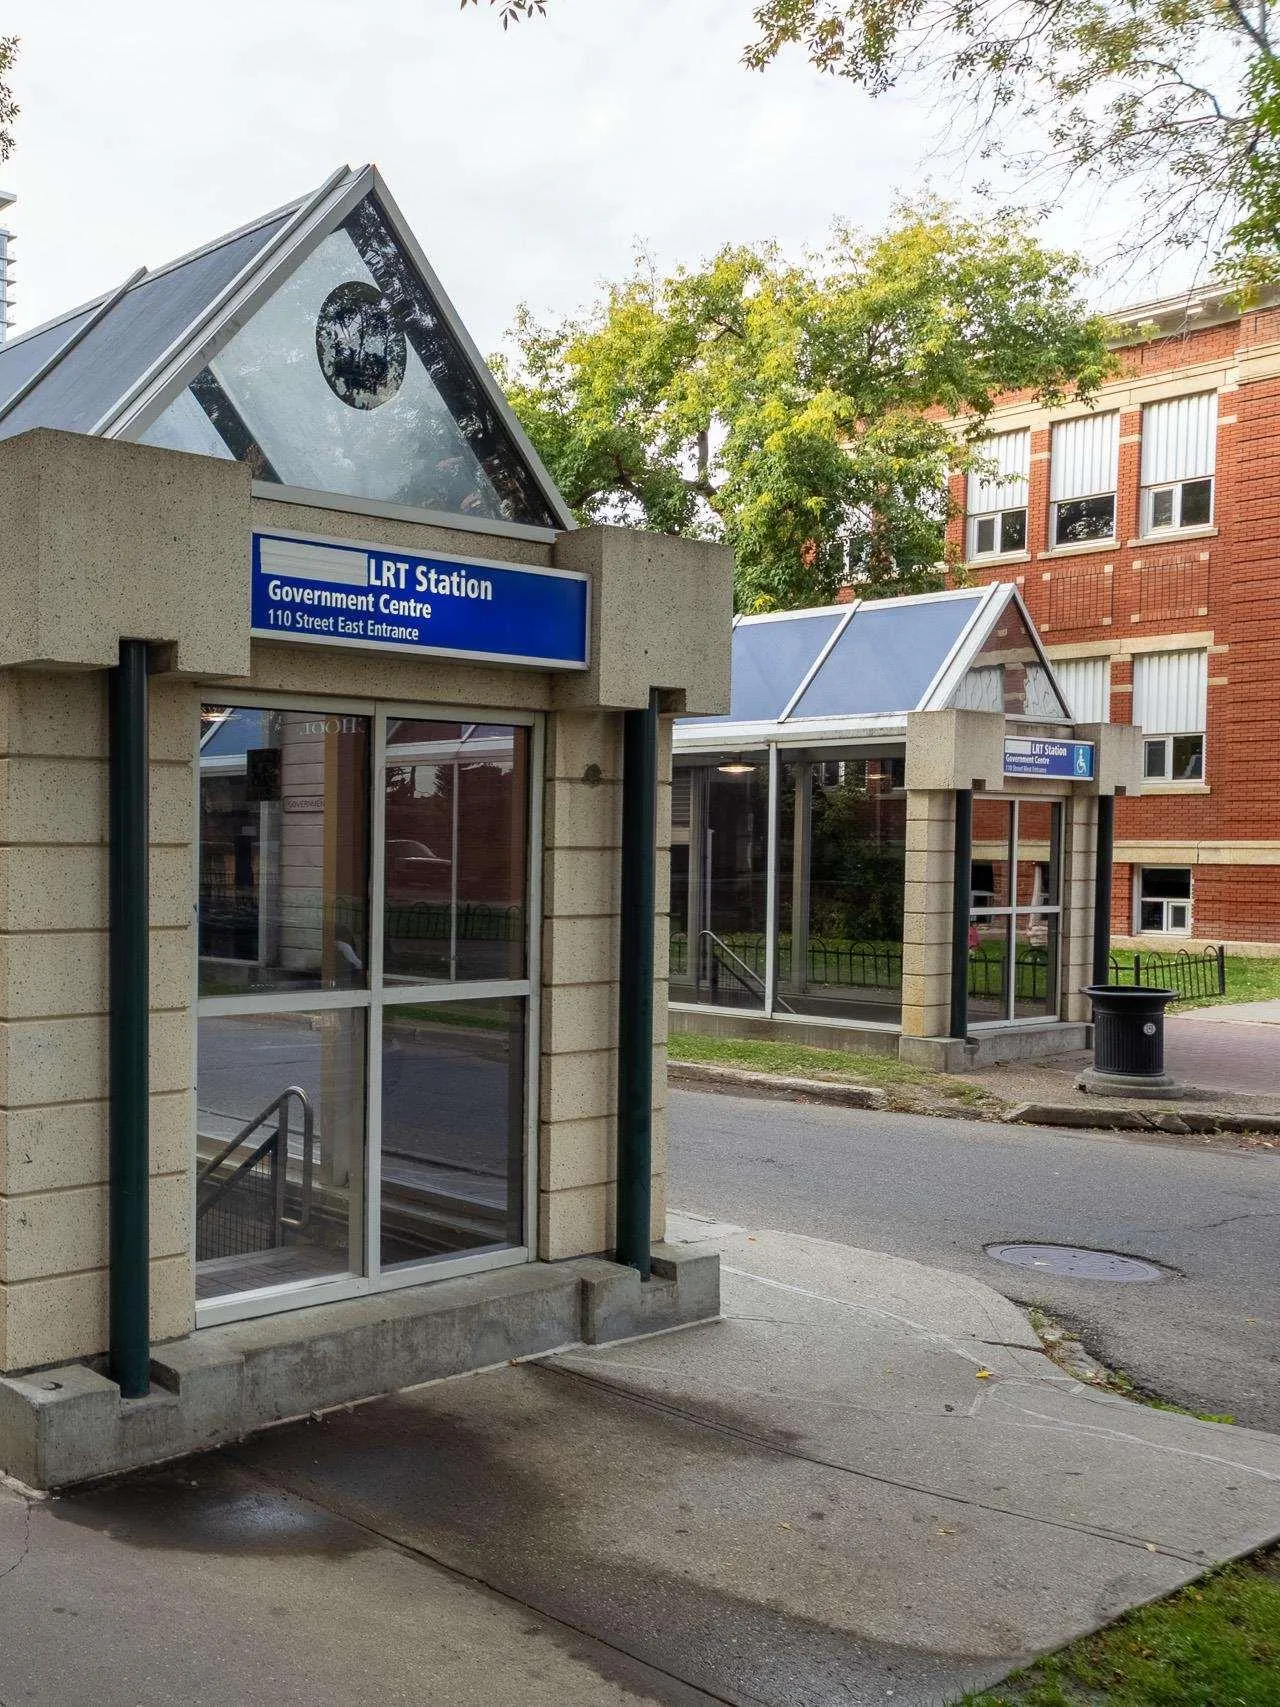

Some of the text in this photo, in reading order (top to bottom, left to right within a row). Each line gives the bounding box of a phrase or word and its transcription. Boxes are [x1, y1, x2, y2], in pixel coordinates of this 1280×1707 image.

[369, 558, 493, 600] LRT Station
[268, 579, 432, 619] Government Centre
[268, 608, 419, 640] 110 Street East Entrance
[1005, 753, 1035, 764] Government
[1032, 743, 1067, 757] LRT Station
